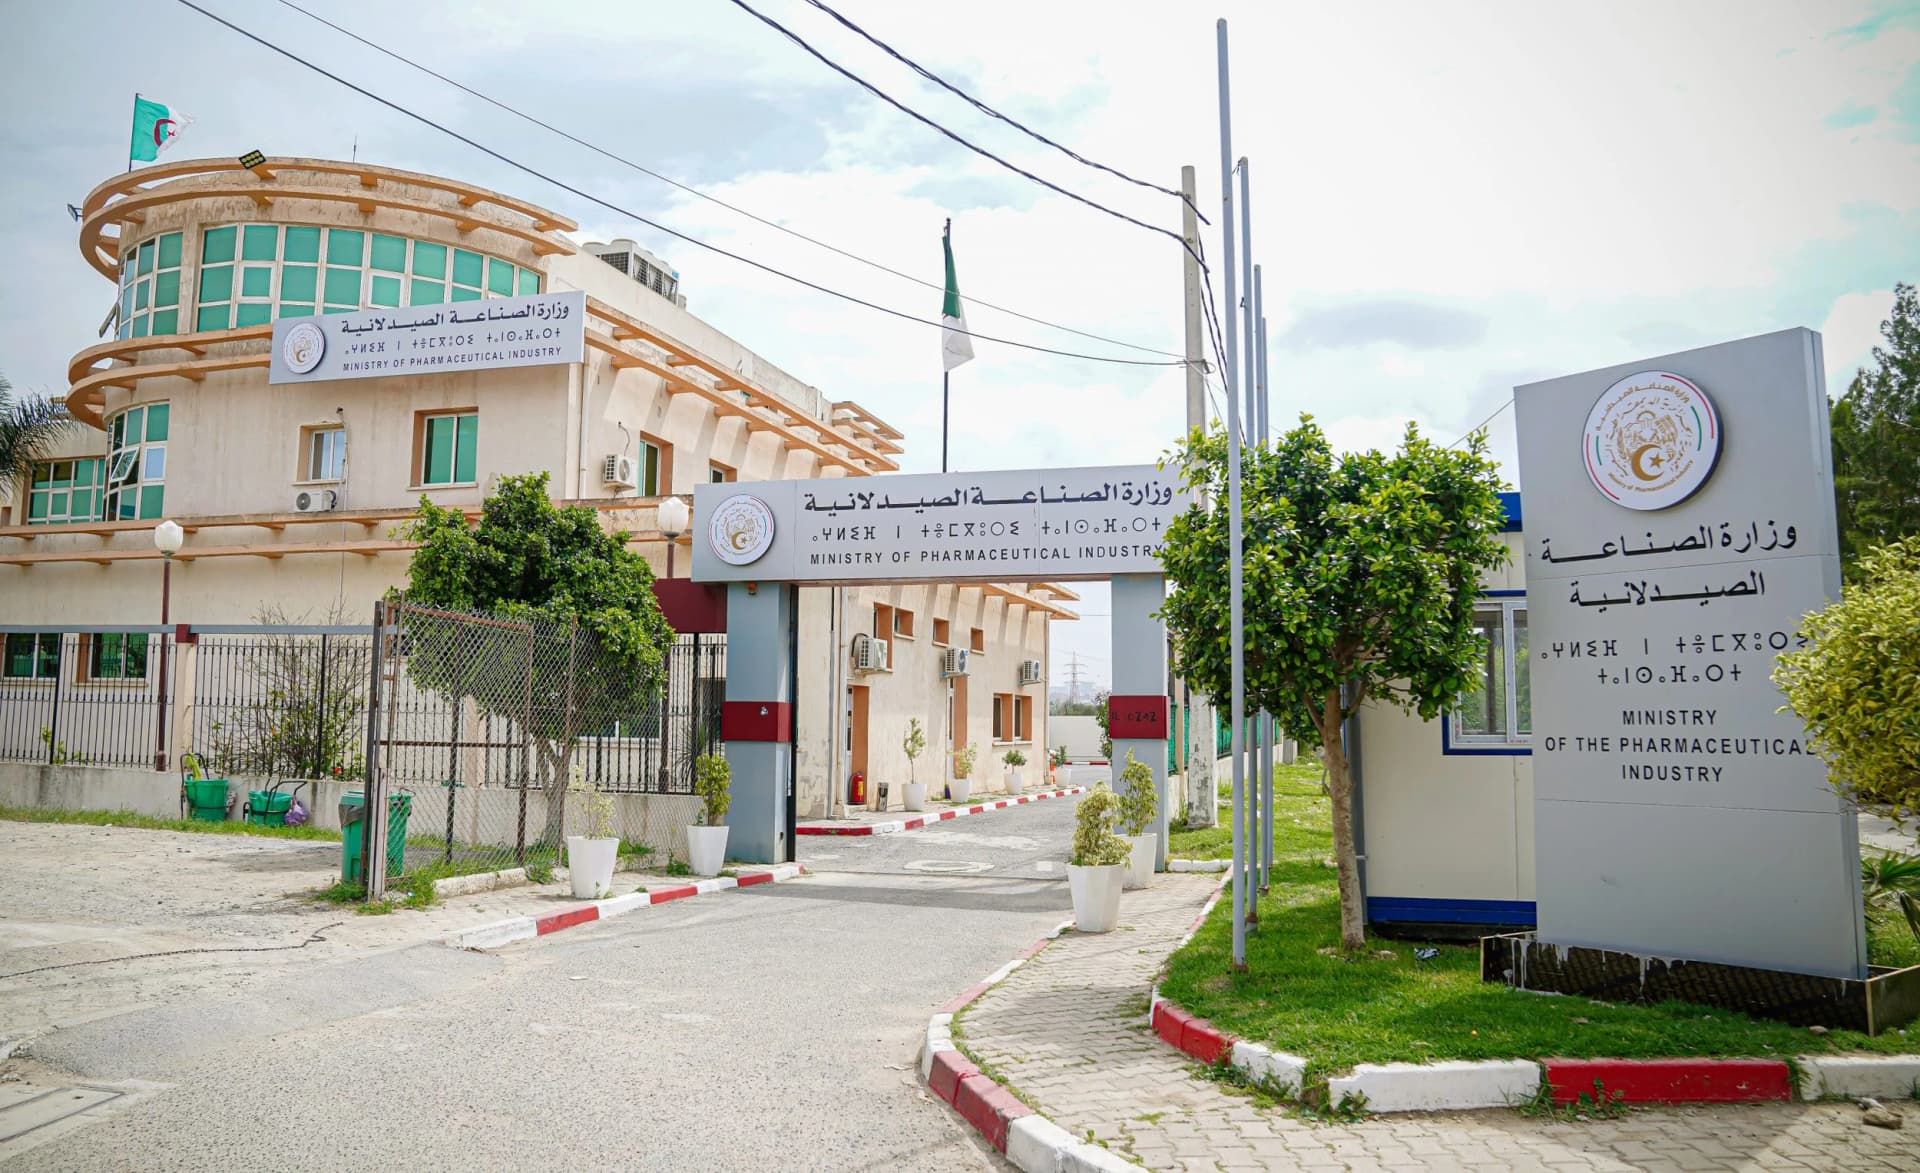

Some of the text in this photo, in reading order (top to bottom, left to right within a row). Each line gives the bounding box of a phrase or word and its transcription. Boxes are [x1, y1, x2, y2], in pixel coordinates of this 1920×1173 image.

[341, 302, 570, 336] وزارة الصناعة الصيدلانية
[343, 347, 561, 371] MINISTRY OF PHARMACEUTICAL INDUSTRY
[804, 481, 1173, 514] وزارة الصناعة الصيدلانية
[1541, 520, 1797, 564] وزارة الصناعة
[810, 544, 1163, 565] MINISTRY OF PHARMACEUTICAL INDUSTRY
[1569, 571, 1765, 613] الصيدلانية
[1622, 710, 1717, 725] MINISTRY
[1545, 737, 1567, 751] OF
[1576, 737, 1610, 752] THE
[1622, 765, 1723, 781] INDUSTRY
